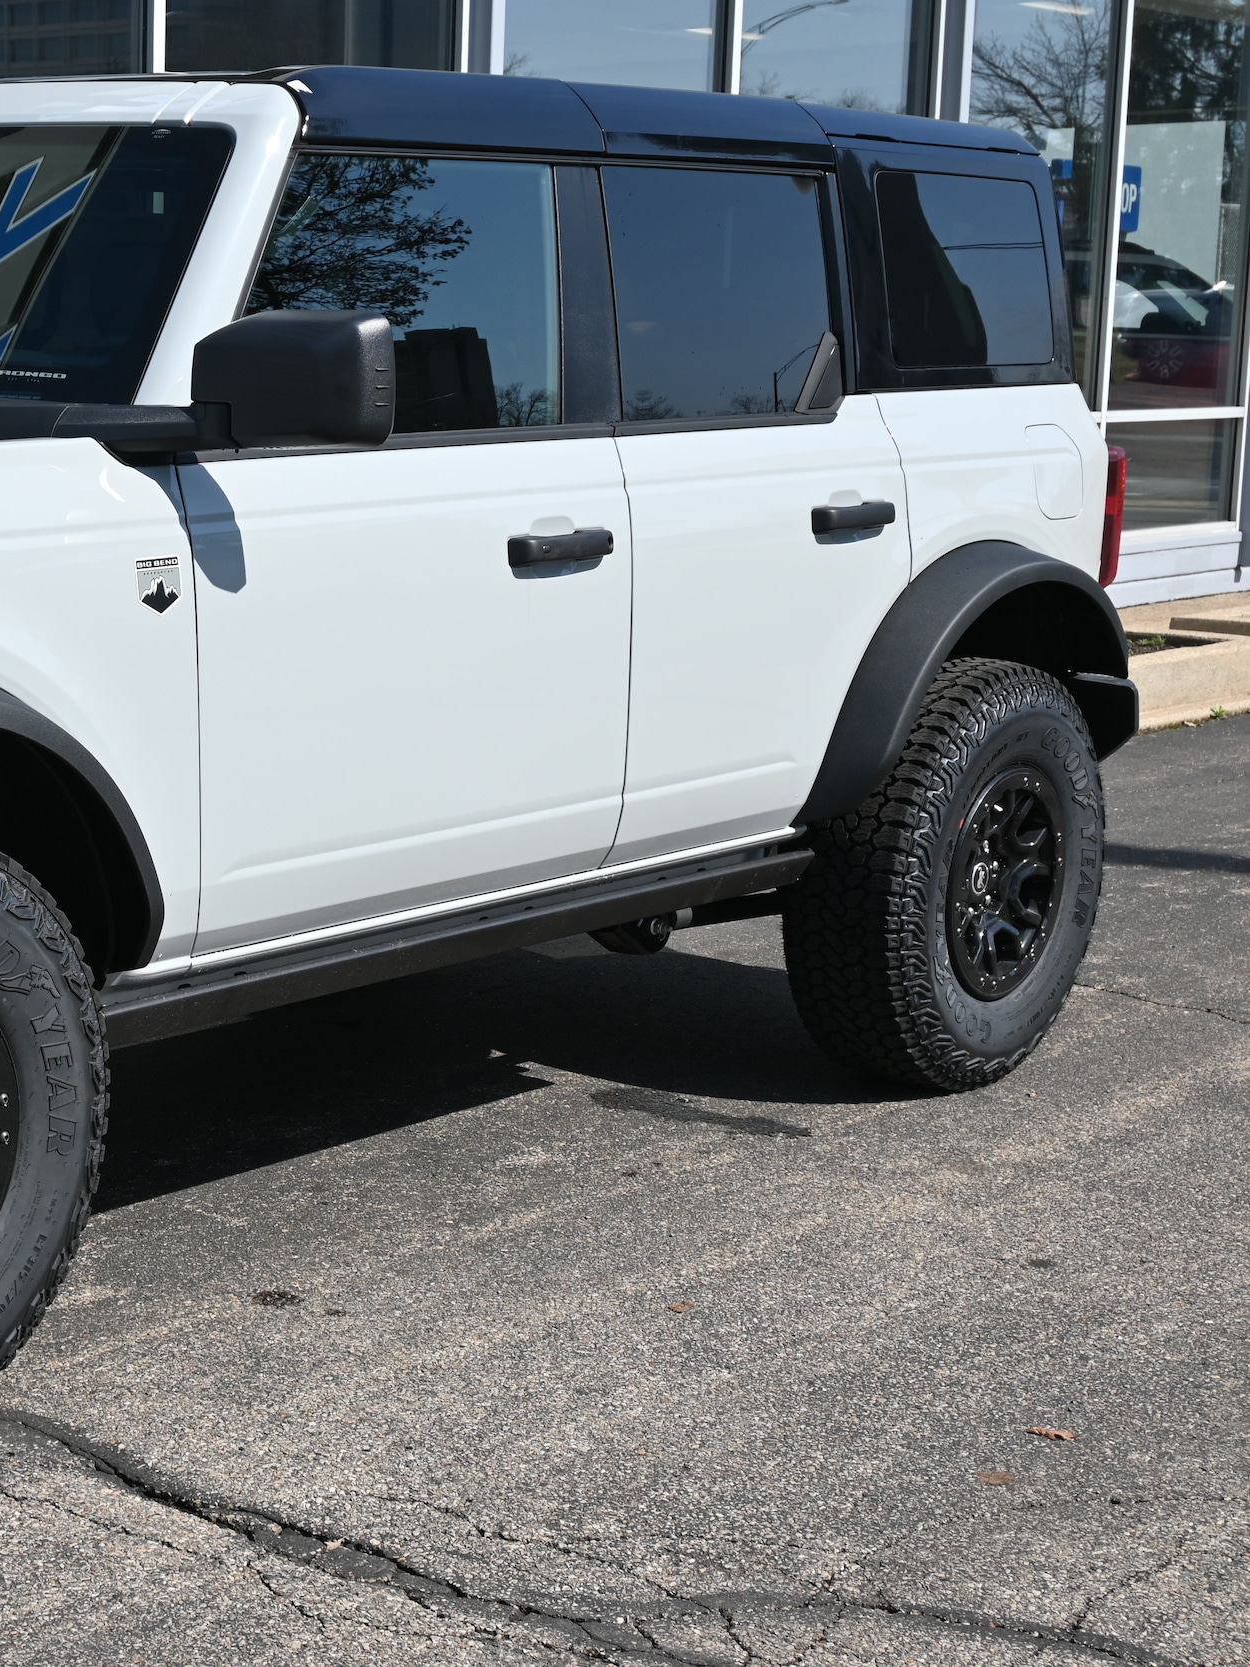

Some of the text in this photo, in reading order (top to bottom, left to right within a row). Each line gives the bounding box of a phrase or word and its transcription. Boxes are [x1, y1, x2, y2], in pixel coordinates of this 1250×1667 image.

[136, 558, 178, 569] BIG BEND
[1041, 727, 1099, 929] GOODYEAR
